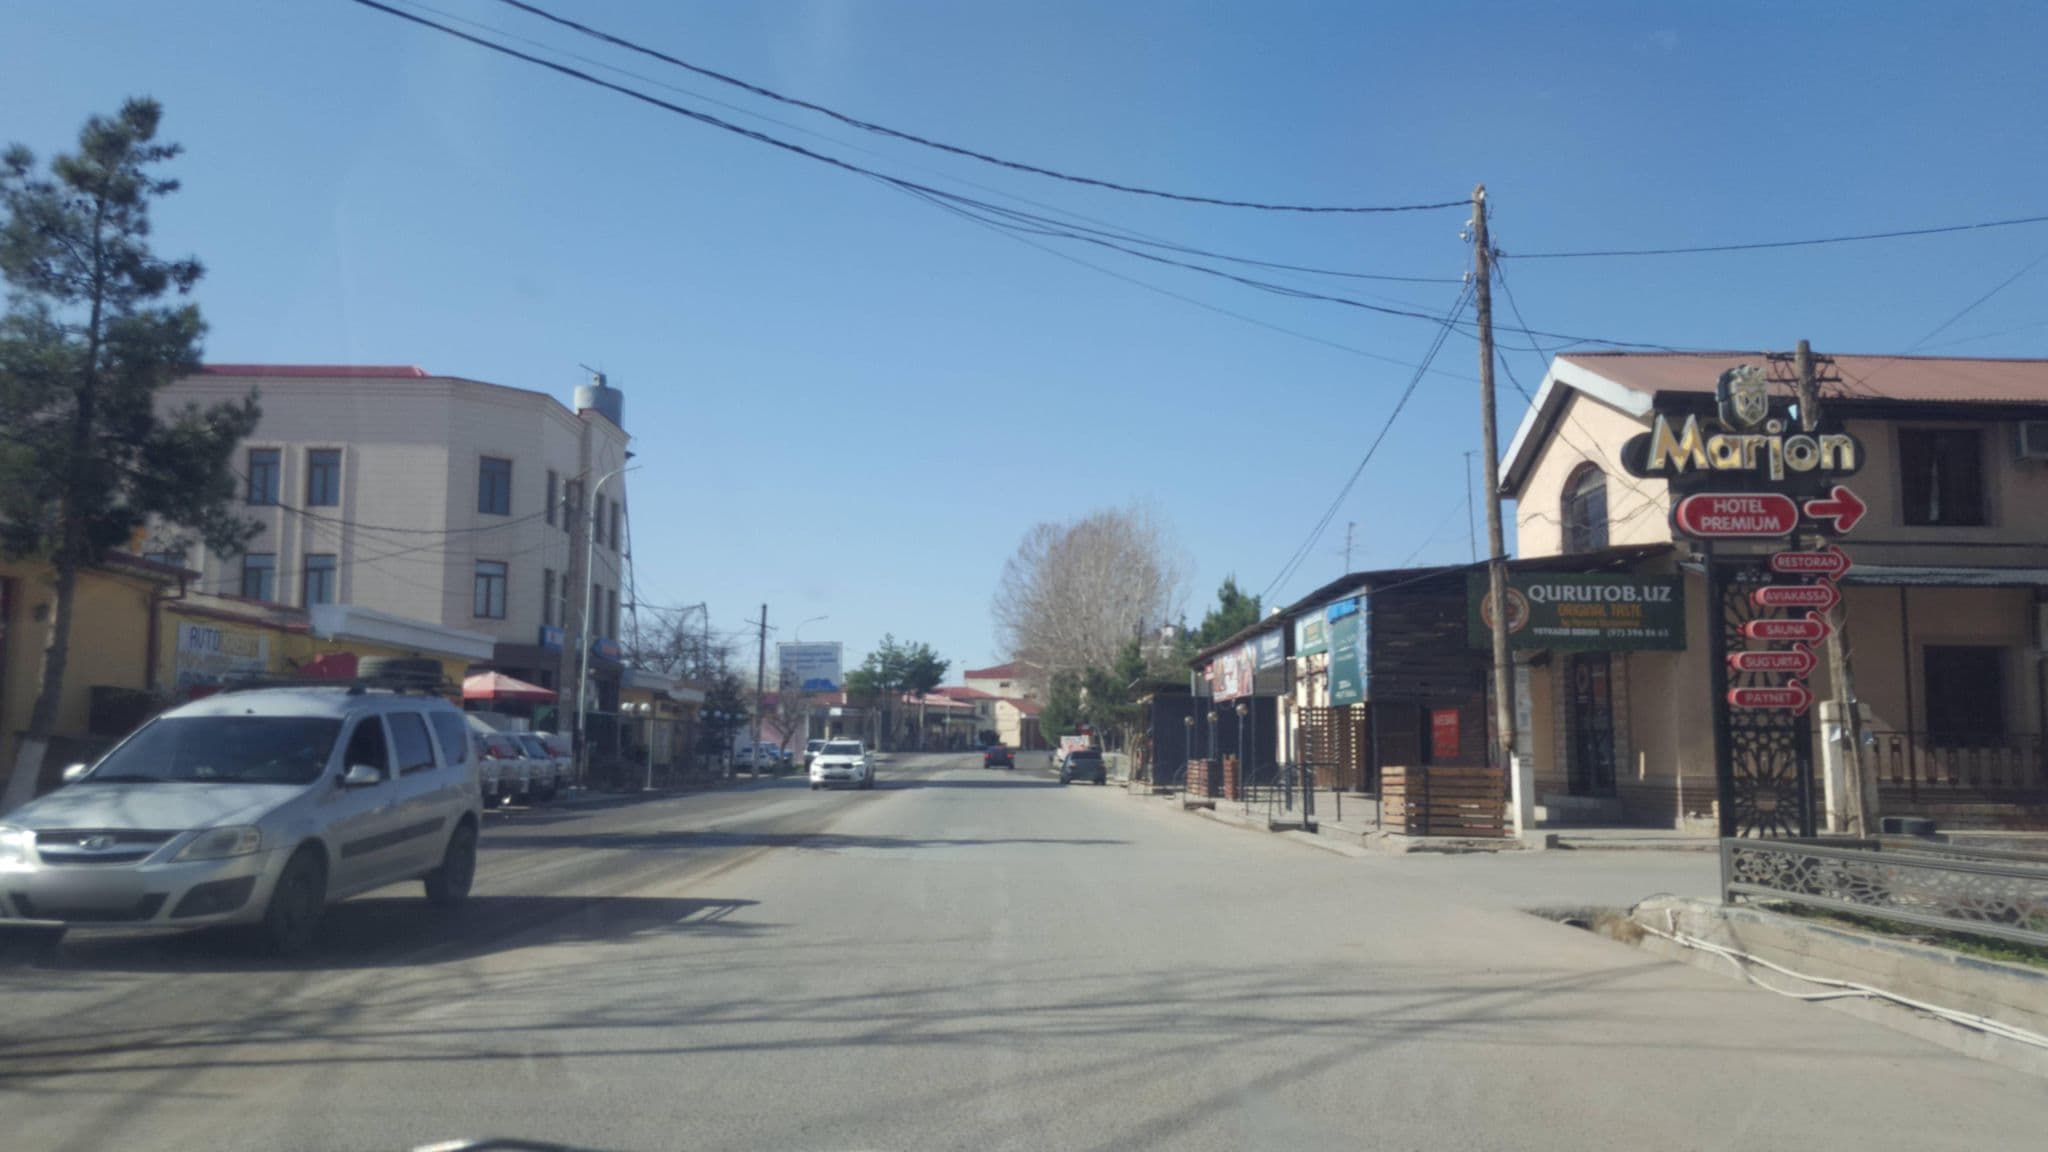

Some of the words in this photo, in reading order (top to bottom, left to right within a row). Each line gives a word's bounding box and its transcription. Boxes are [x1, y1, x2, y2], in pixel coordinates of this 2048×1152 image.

[1647, 413, 1855, 481] Marjon
[1713, 500, 1766, 513] HOTEL
[1701, 516, 1780, 531] PREMIUM
[1777, 556, 1838, 567] RESTORAN
[1528, 585, 1672, 603] QURUTOB.UZ
[1765, 592, 1828, 601] AVIAKASSA
[1766, 624, 1807, 635] SAUNA
[1744, 692, 1792, 703] PAYNET
